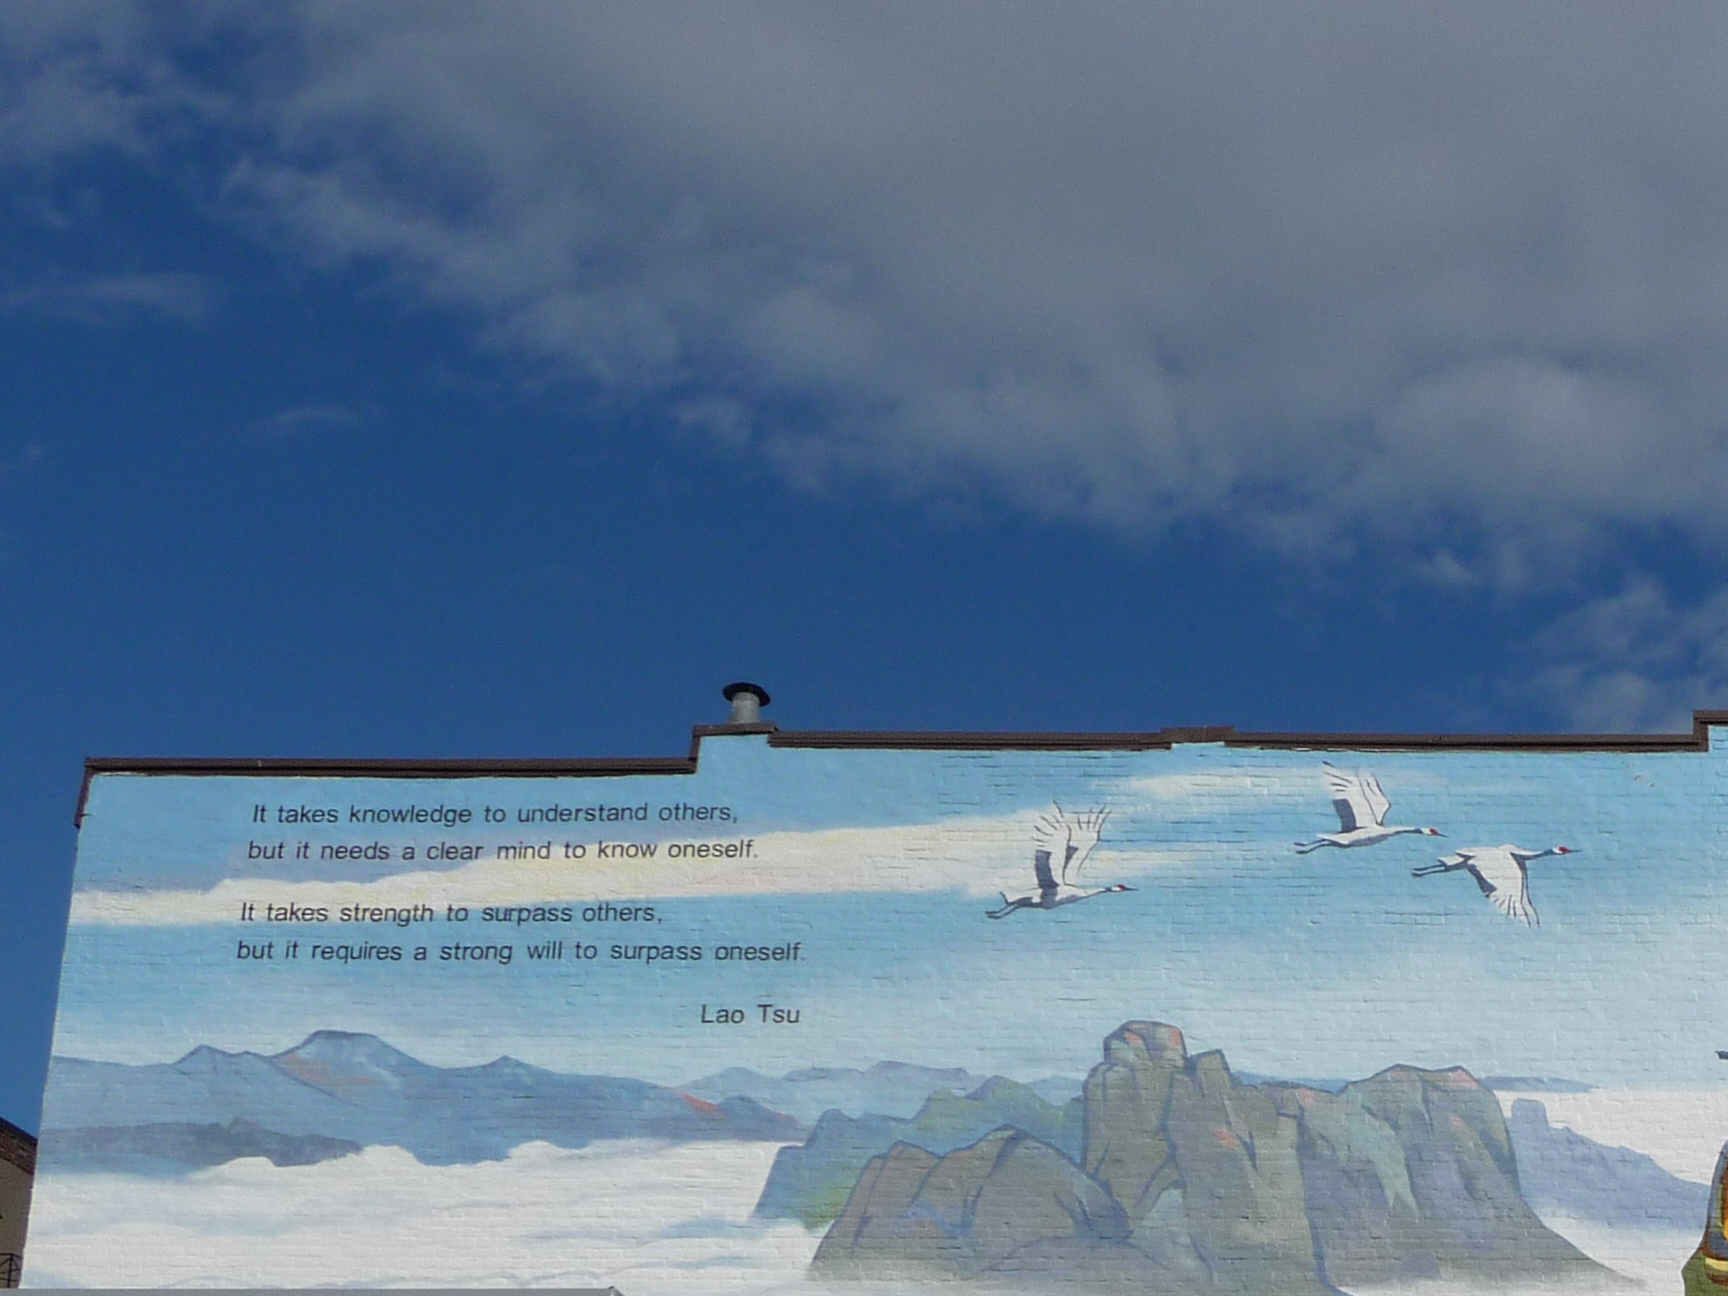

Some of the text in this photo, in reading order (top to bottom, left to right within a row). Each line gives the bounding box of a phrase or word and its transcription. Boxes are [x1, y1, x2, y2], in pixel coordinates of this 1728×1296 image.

[252, 802, 738, 828] It takes knowledge to understand others,
[247, 839, 759, 861] but it needs a clear mind to know oneself.
[240, 900, 663, 928] It takes strength to surpass others,
[236, 939, 806, 966] but it requires a strong will to surpass oneself.
[700, 1003, 801, 1025] Lao Tsu
